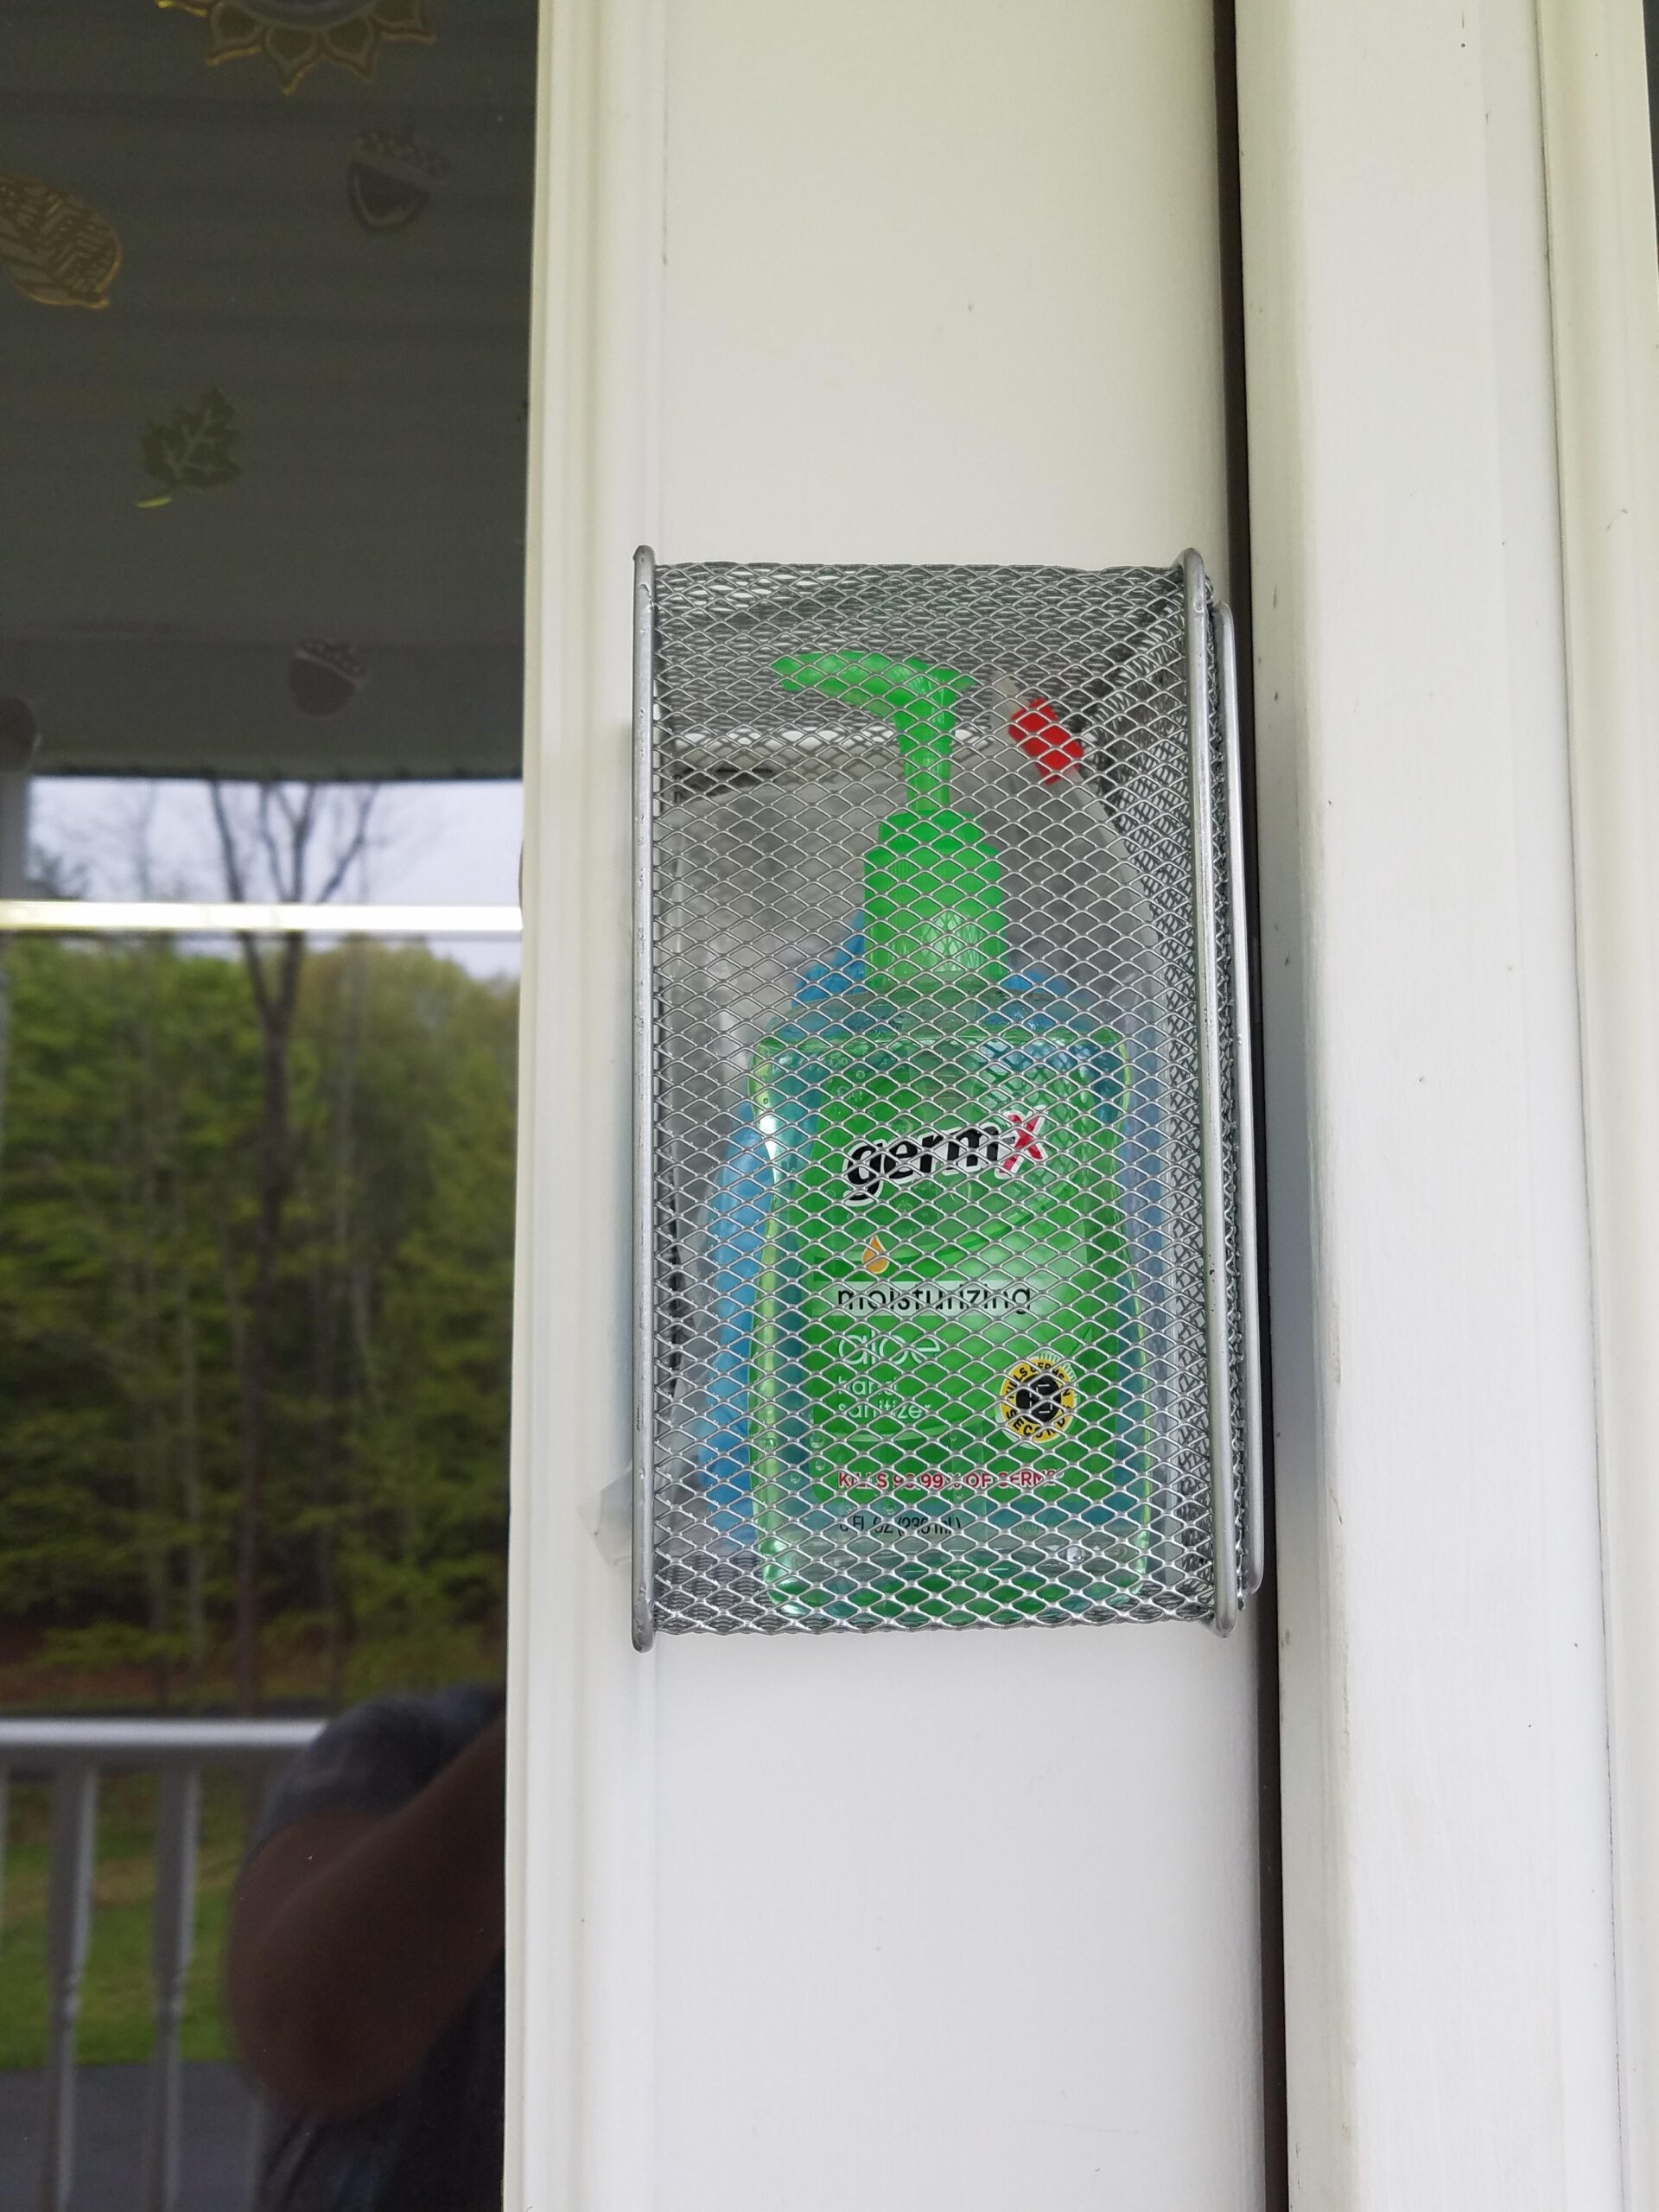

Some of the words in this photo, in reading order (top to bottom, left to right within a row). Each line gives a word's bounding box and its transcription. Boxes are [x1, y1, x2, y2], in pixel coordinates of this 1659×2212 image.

[838, 1328, 941, 1365] aloe
[1005, 1403, 1071, 1439] SECOND
[892, 1472, 963, 1489] 999
[966, 1471, 993, 1488] OF
